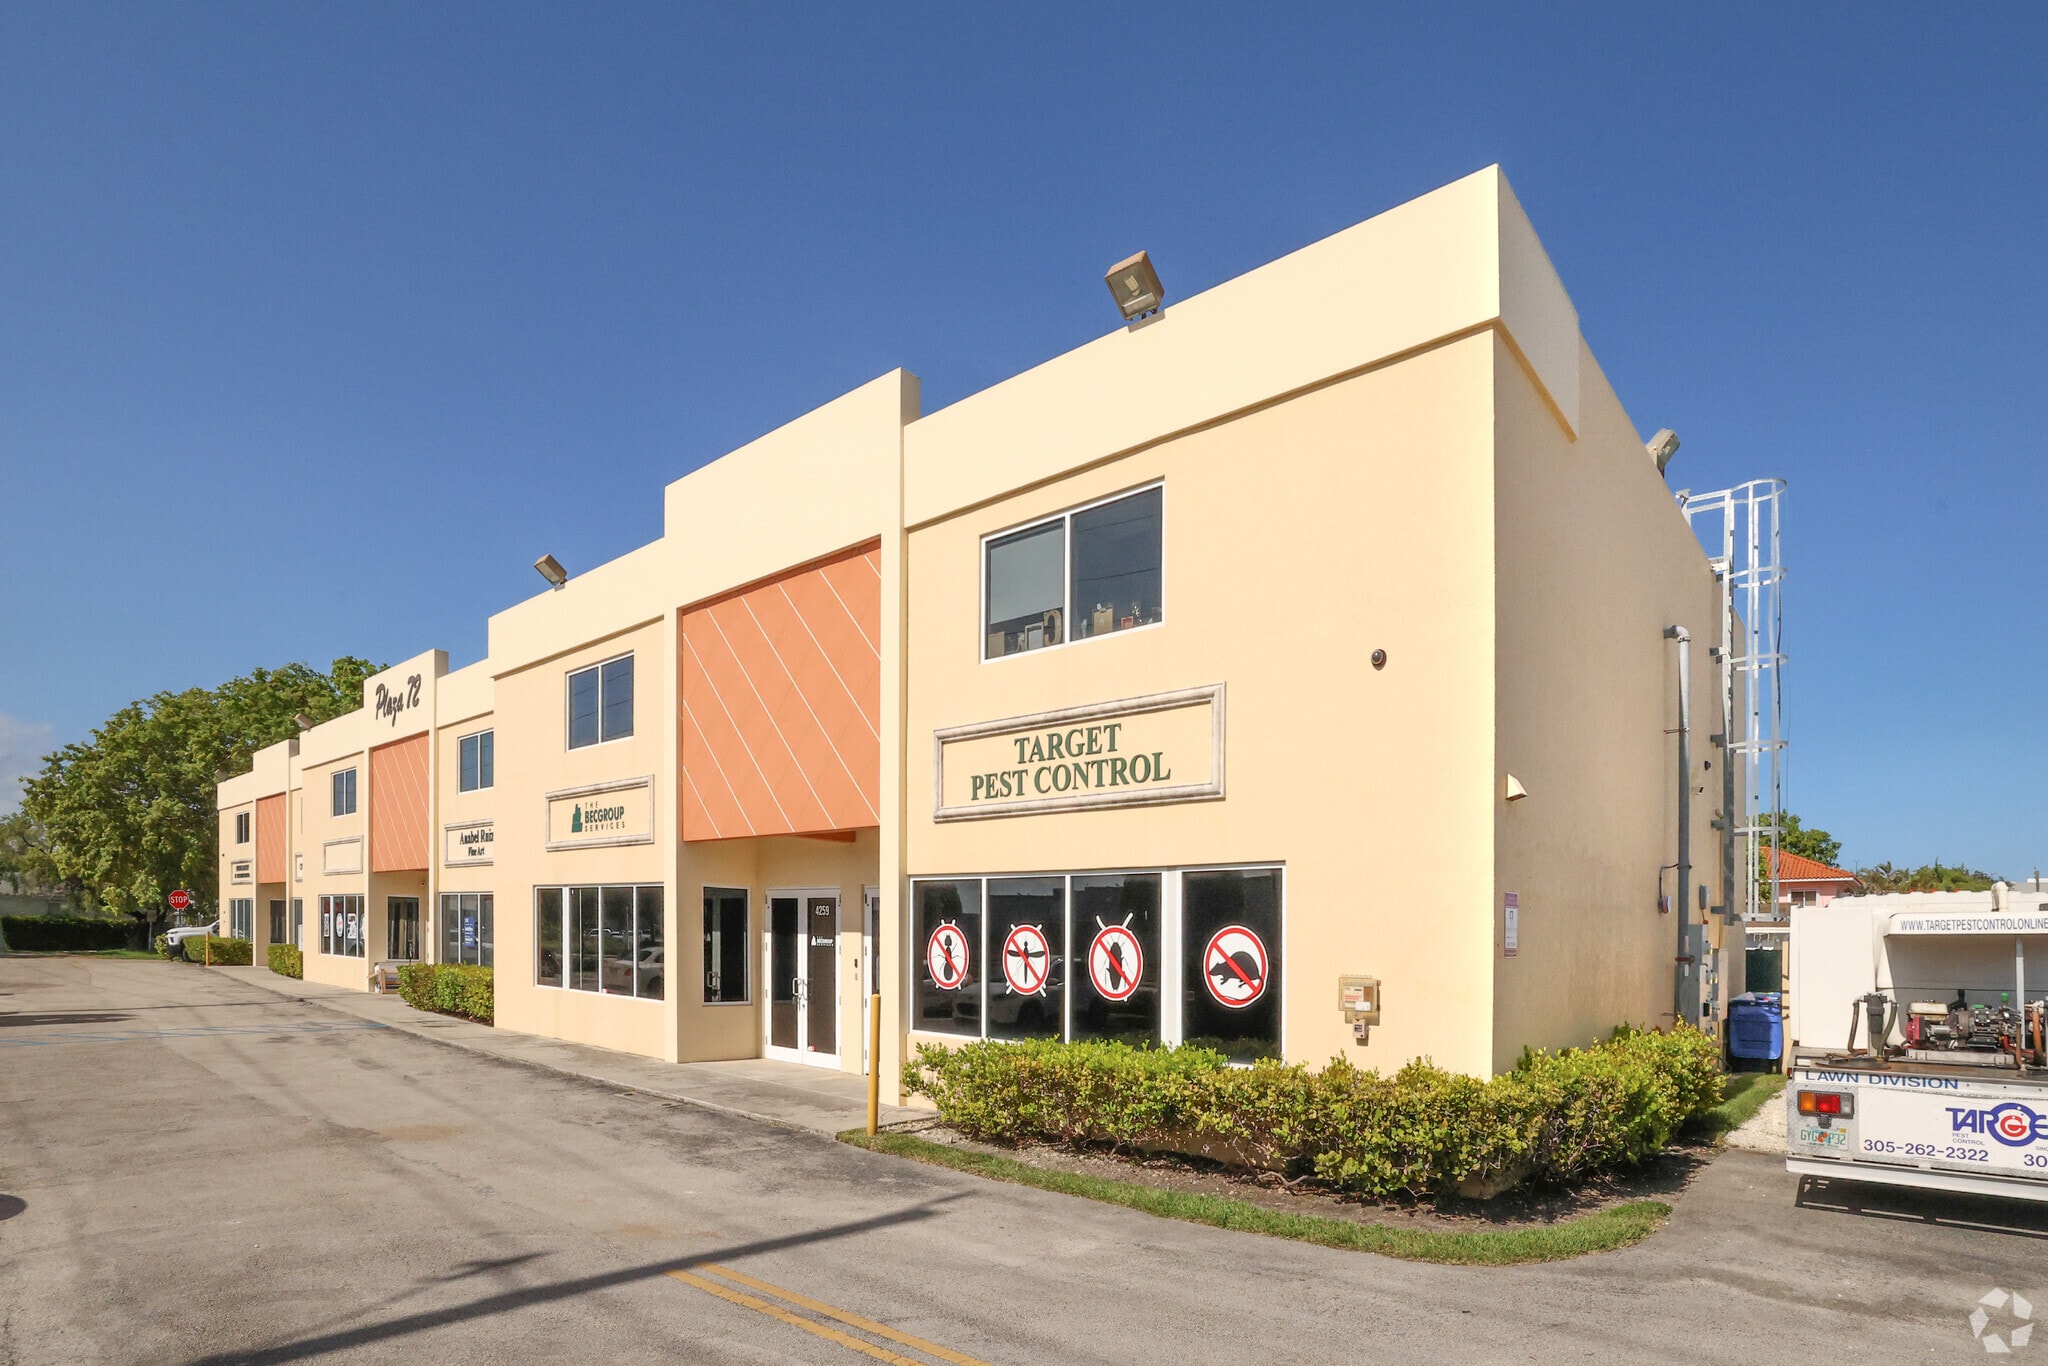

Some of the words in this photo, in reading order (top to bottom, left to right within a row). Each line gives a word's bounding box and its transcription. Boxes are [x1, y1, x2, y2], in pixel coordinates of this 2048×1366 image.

[375, 683, 404, 728] Plaza
[407, 673, 422, 710] 72
[1014, 723, 1122, 764] TARGET
[971, 769, 1029, 801] PEST
[1033, 752, 1171, 794] CONTROL
[585, 801, 599, 809] THE
[584, 806, 625, 824] BECGROUP
[584, 821, 626, 833] SERVICES
[170, 896, 188, 904] STOP
[815, 905, 830, 916] 4259
[1805, 1070, 1859, 1083] LAWN
[1868, 1074, 1959, 1090] DIVISION
[1863, 1139, 1989, 1162] 305-262-2322
[1952, 1138, 1985, 1146] CONTROL
